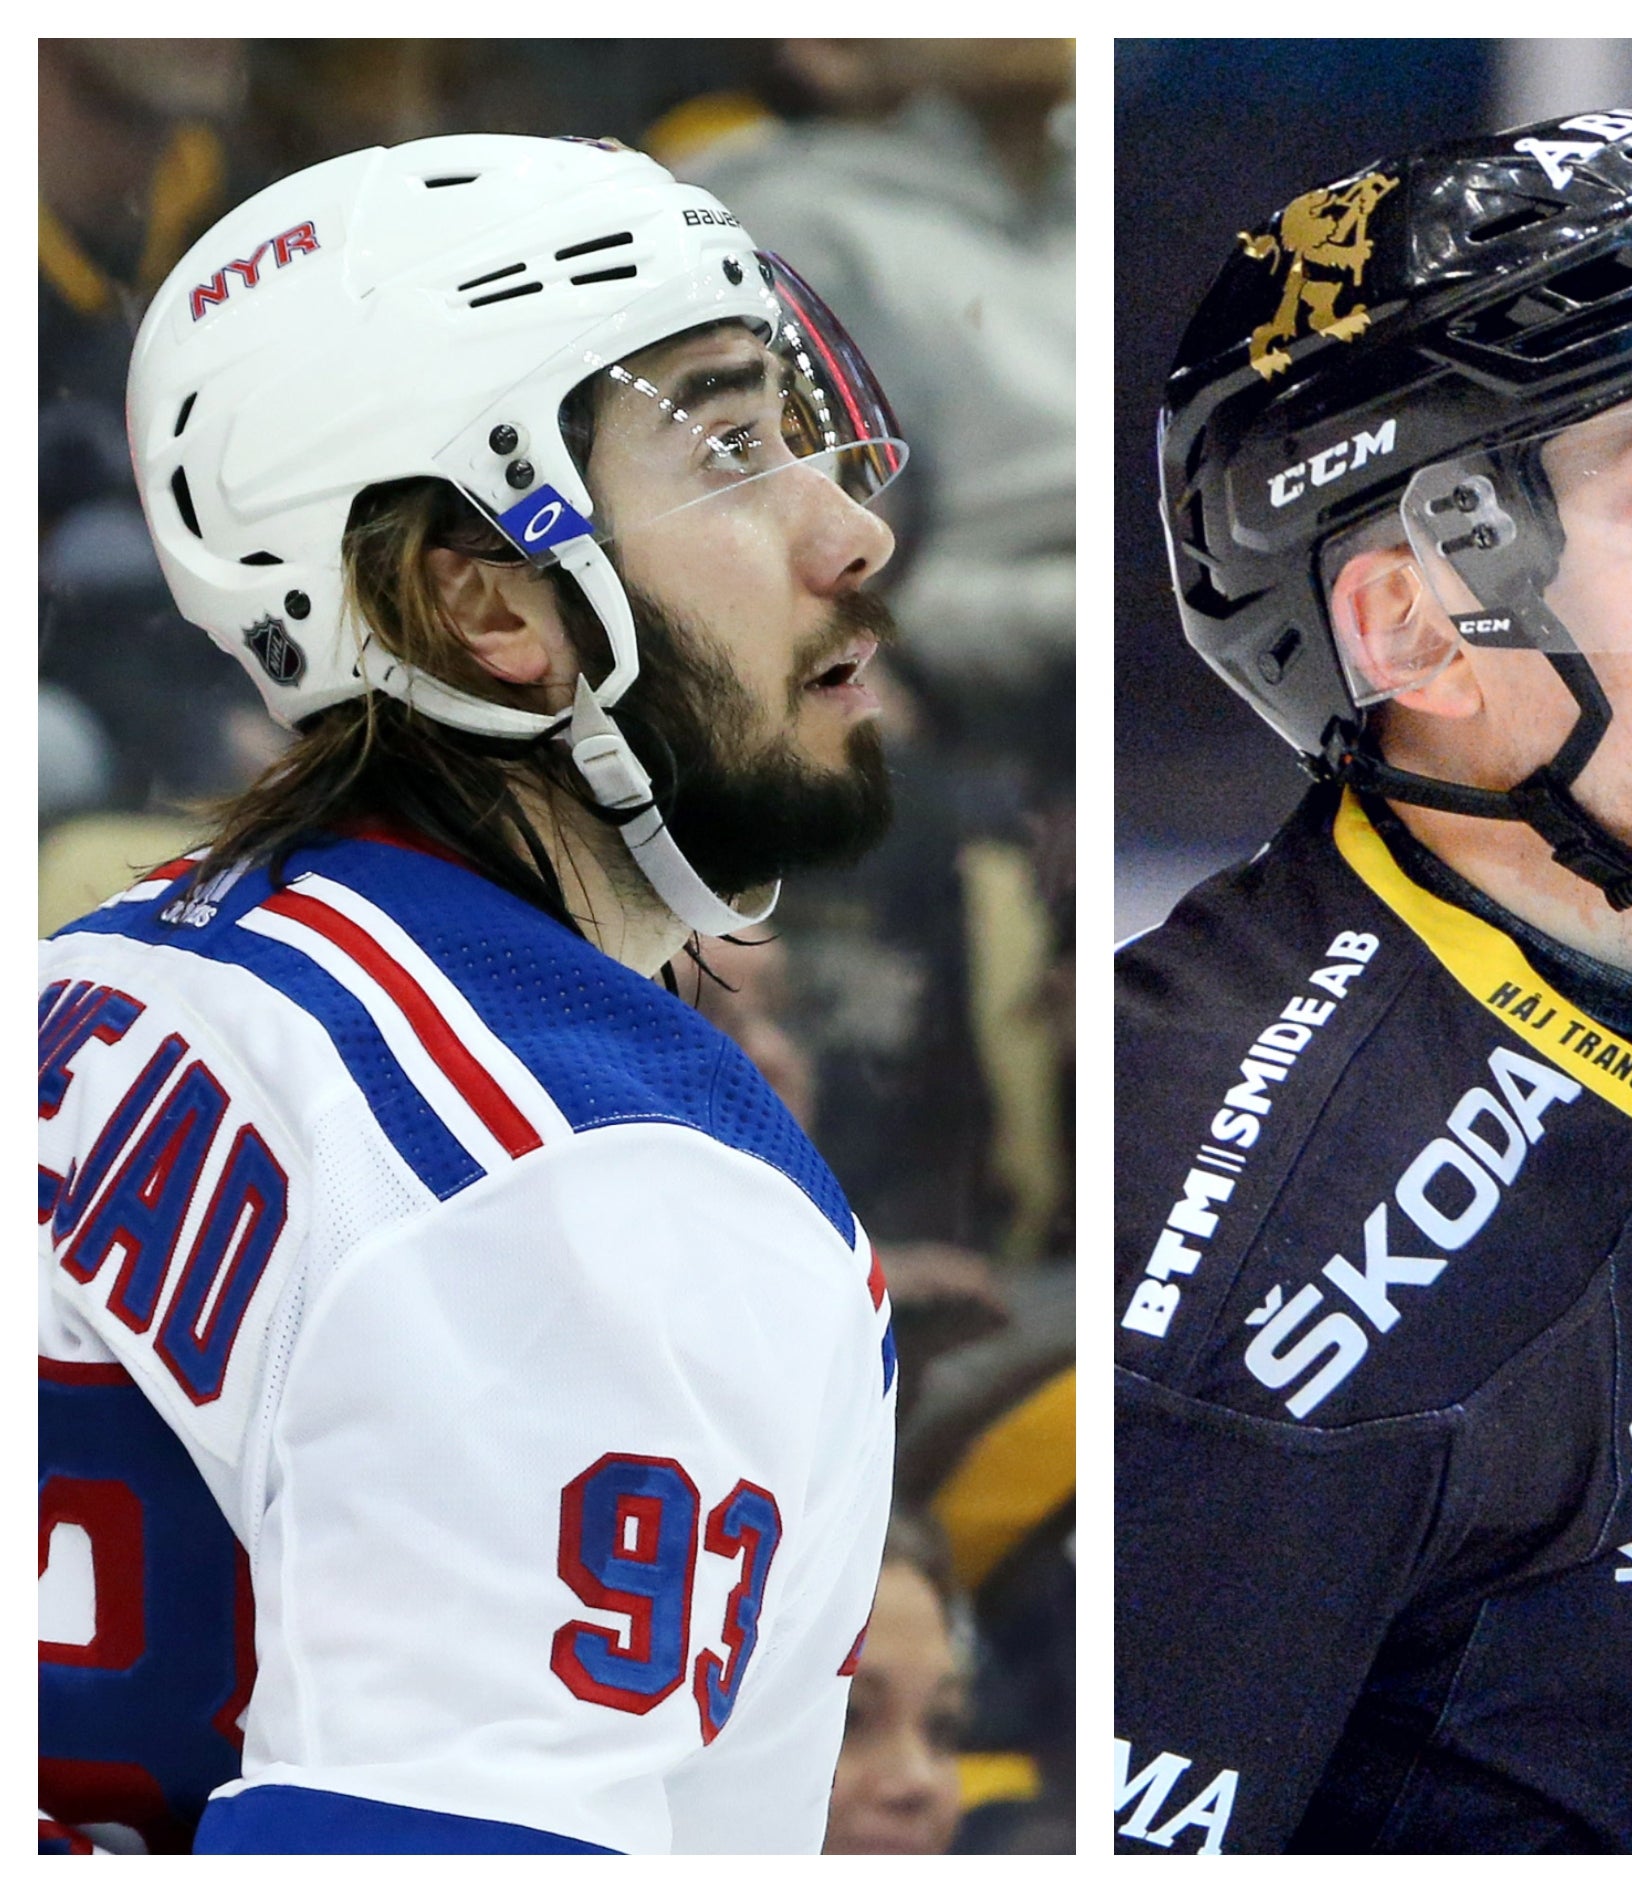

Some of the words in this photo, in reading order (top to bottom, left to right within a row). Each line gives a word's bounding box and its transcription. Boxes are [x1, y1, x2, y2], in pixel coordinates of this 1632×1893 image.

[188, 221, 321, 322] NYR
[1267, 418, 1397, 508] CCM
[1460, 618, 1511, 634] CCM
[1308, 930, 1380, 999] AB
[1487, 981, 1558, 1030] HÅJ
[1244, 1045, 1583, 1419] ŠKODA
[548, 1451, 783, 1747] 93
